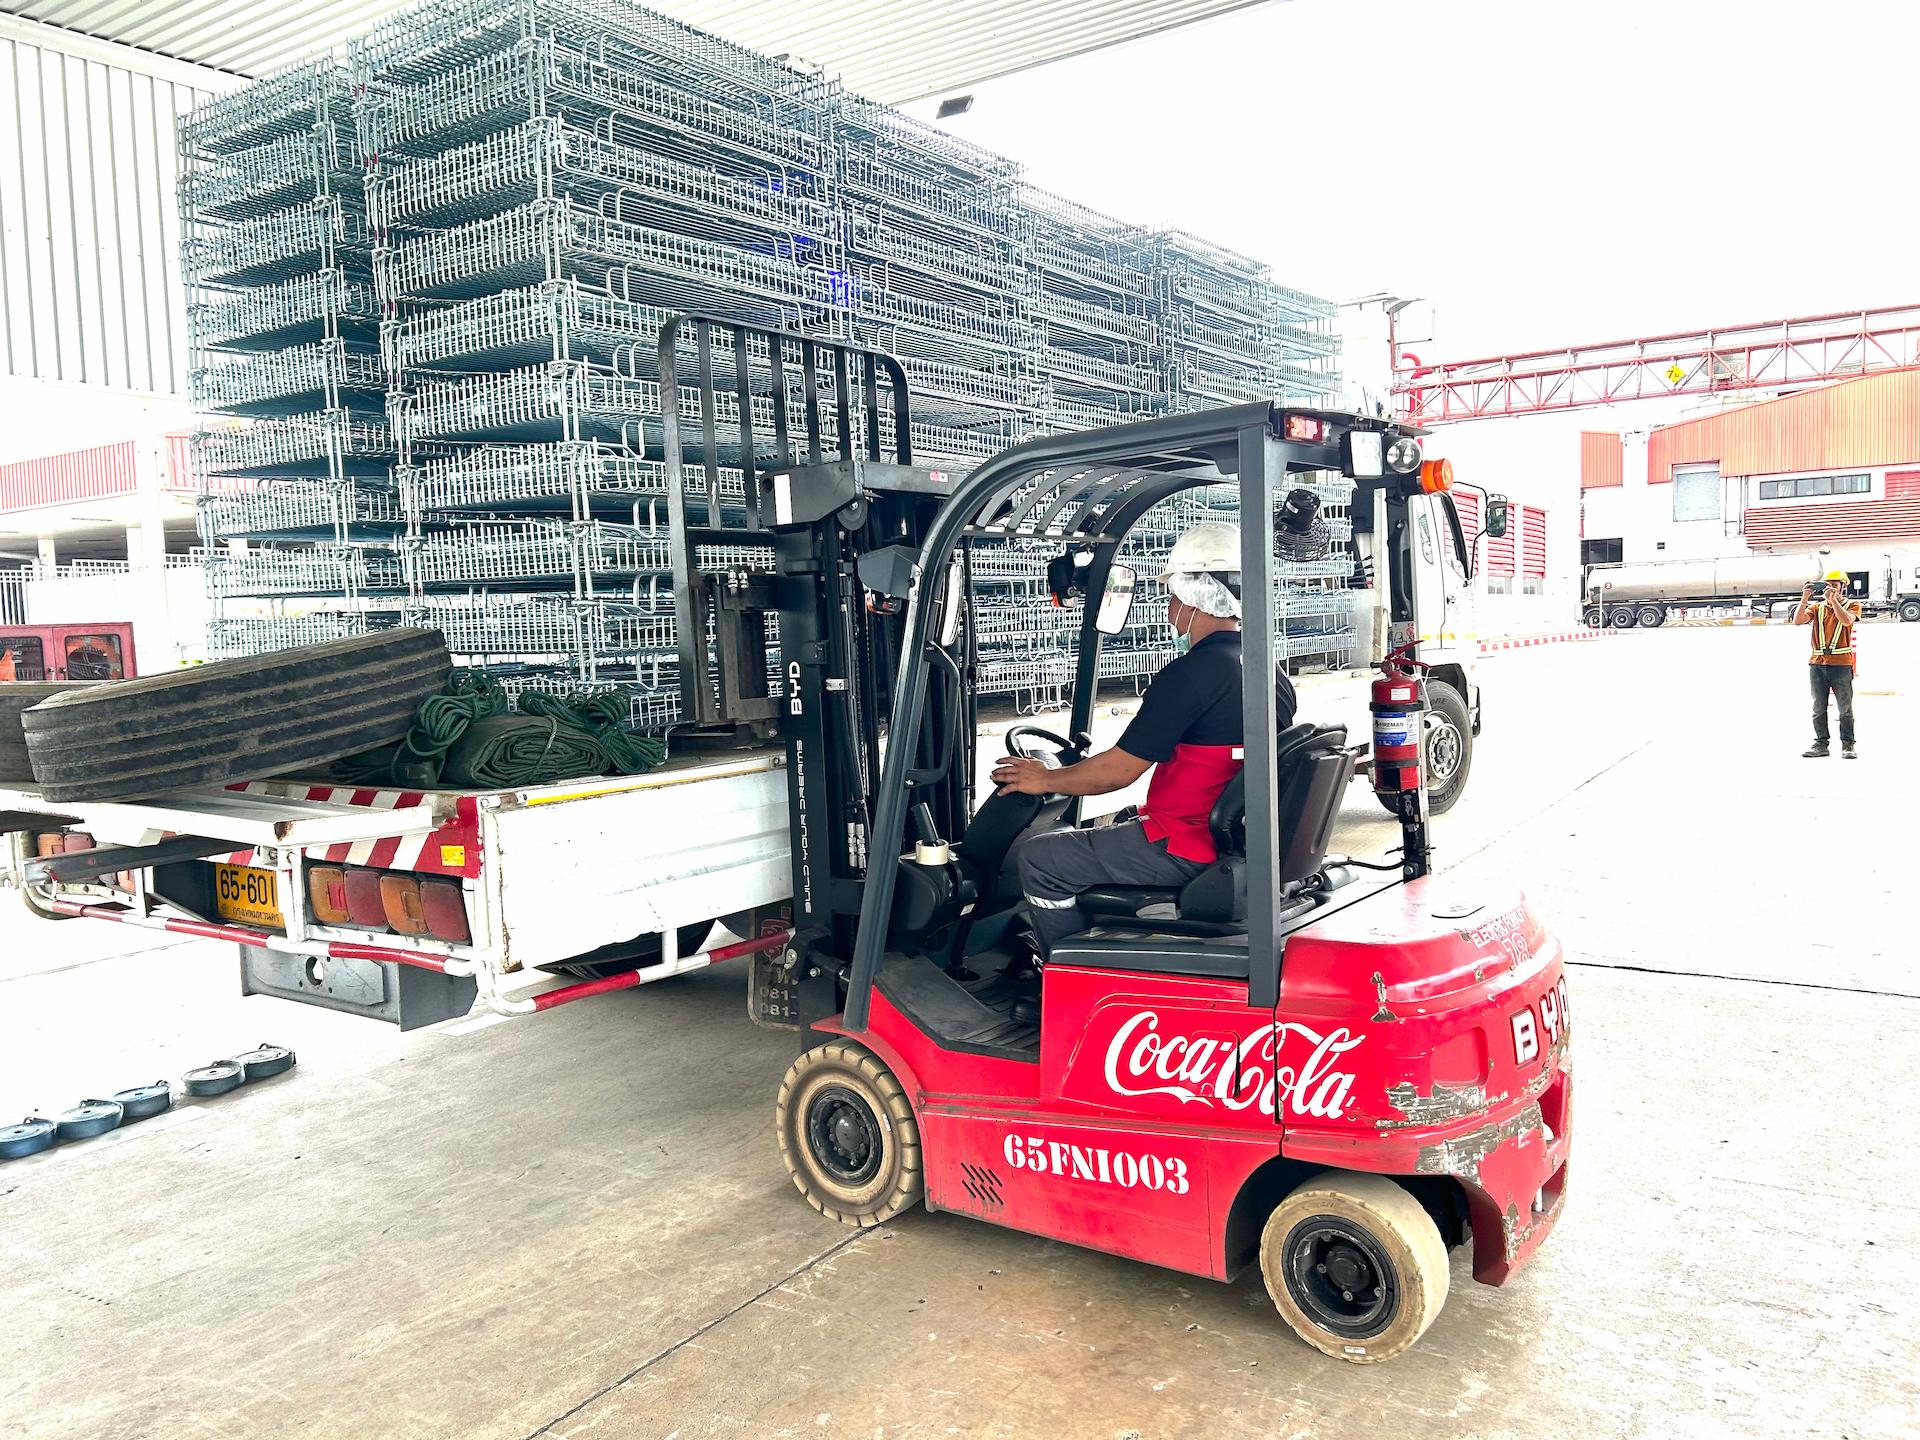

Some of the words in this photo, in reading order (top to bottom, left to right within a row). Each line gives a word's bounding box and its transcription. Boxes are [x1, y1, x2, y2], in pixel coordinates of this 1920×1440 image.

[789, 661, 803, 715] BYD
[796, 739, 807, 810] DREAMS
[799, 813, 809, 856] YOUR
[803, 864, 812, 914] BUILD
[1511, 974, 1570, 1067] BYD
[1104, 1011, 1365, 1120] Coca-Cola
